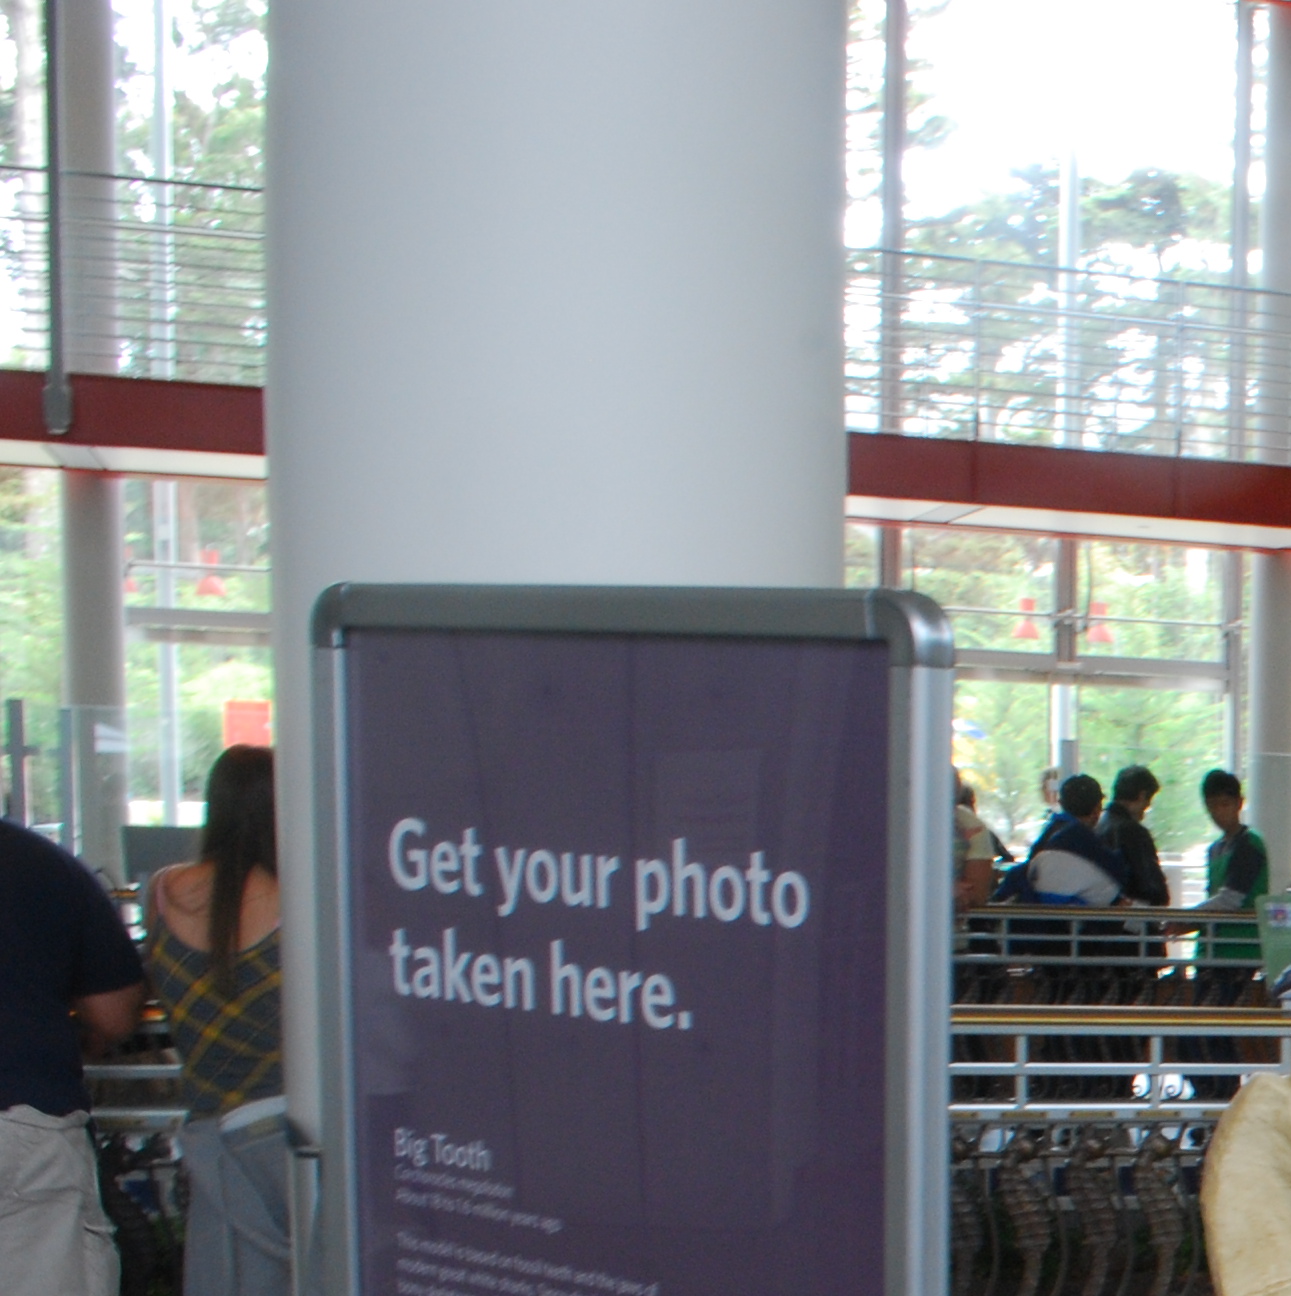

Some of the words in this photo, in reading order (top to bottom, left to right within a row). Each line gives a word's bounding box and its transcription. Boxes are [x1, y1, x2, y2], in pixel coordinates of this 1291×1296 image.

[388, 816, 484, 897] Get
[494, 846, 620, 917] your
[635, 837, 811, 930] photo
[389, 926, 537, 1012] taken
[549, 938, 693, 1030] here.
[394, 1126, 430, 1168] Big
[430, 1132, 493, 1173] Tooth
